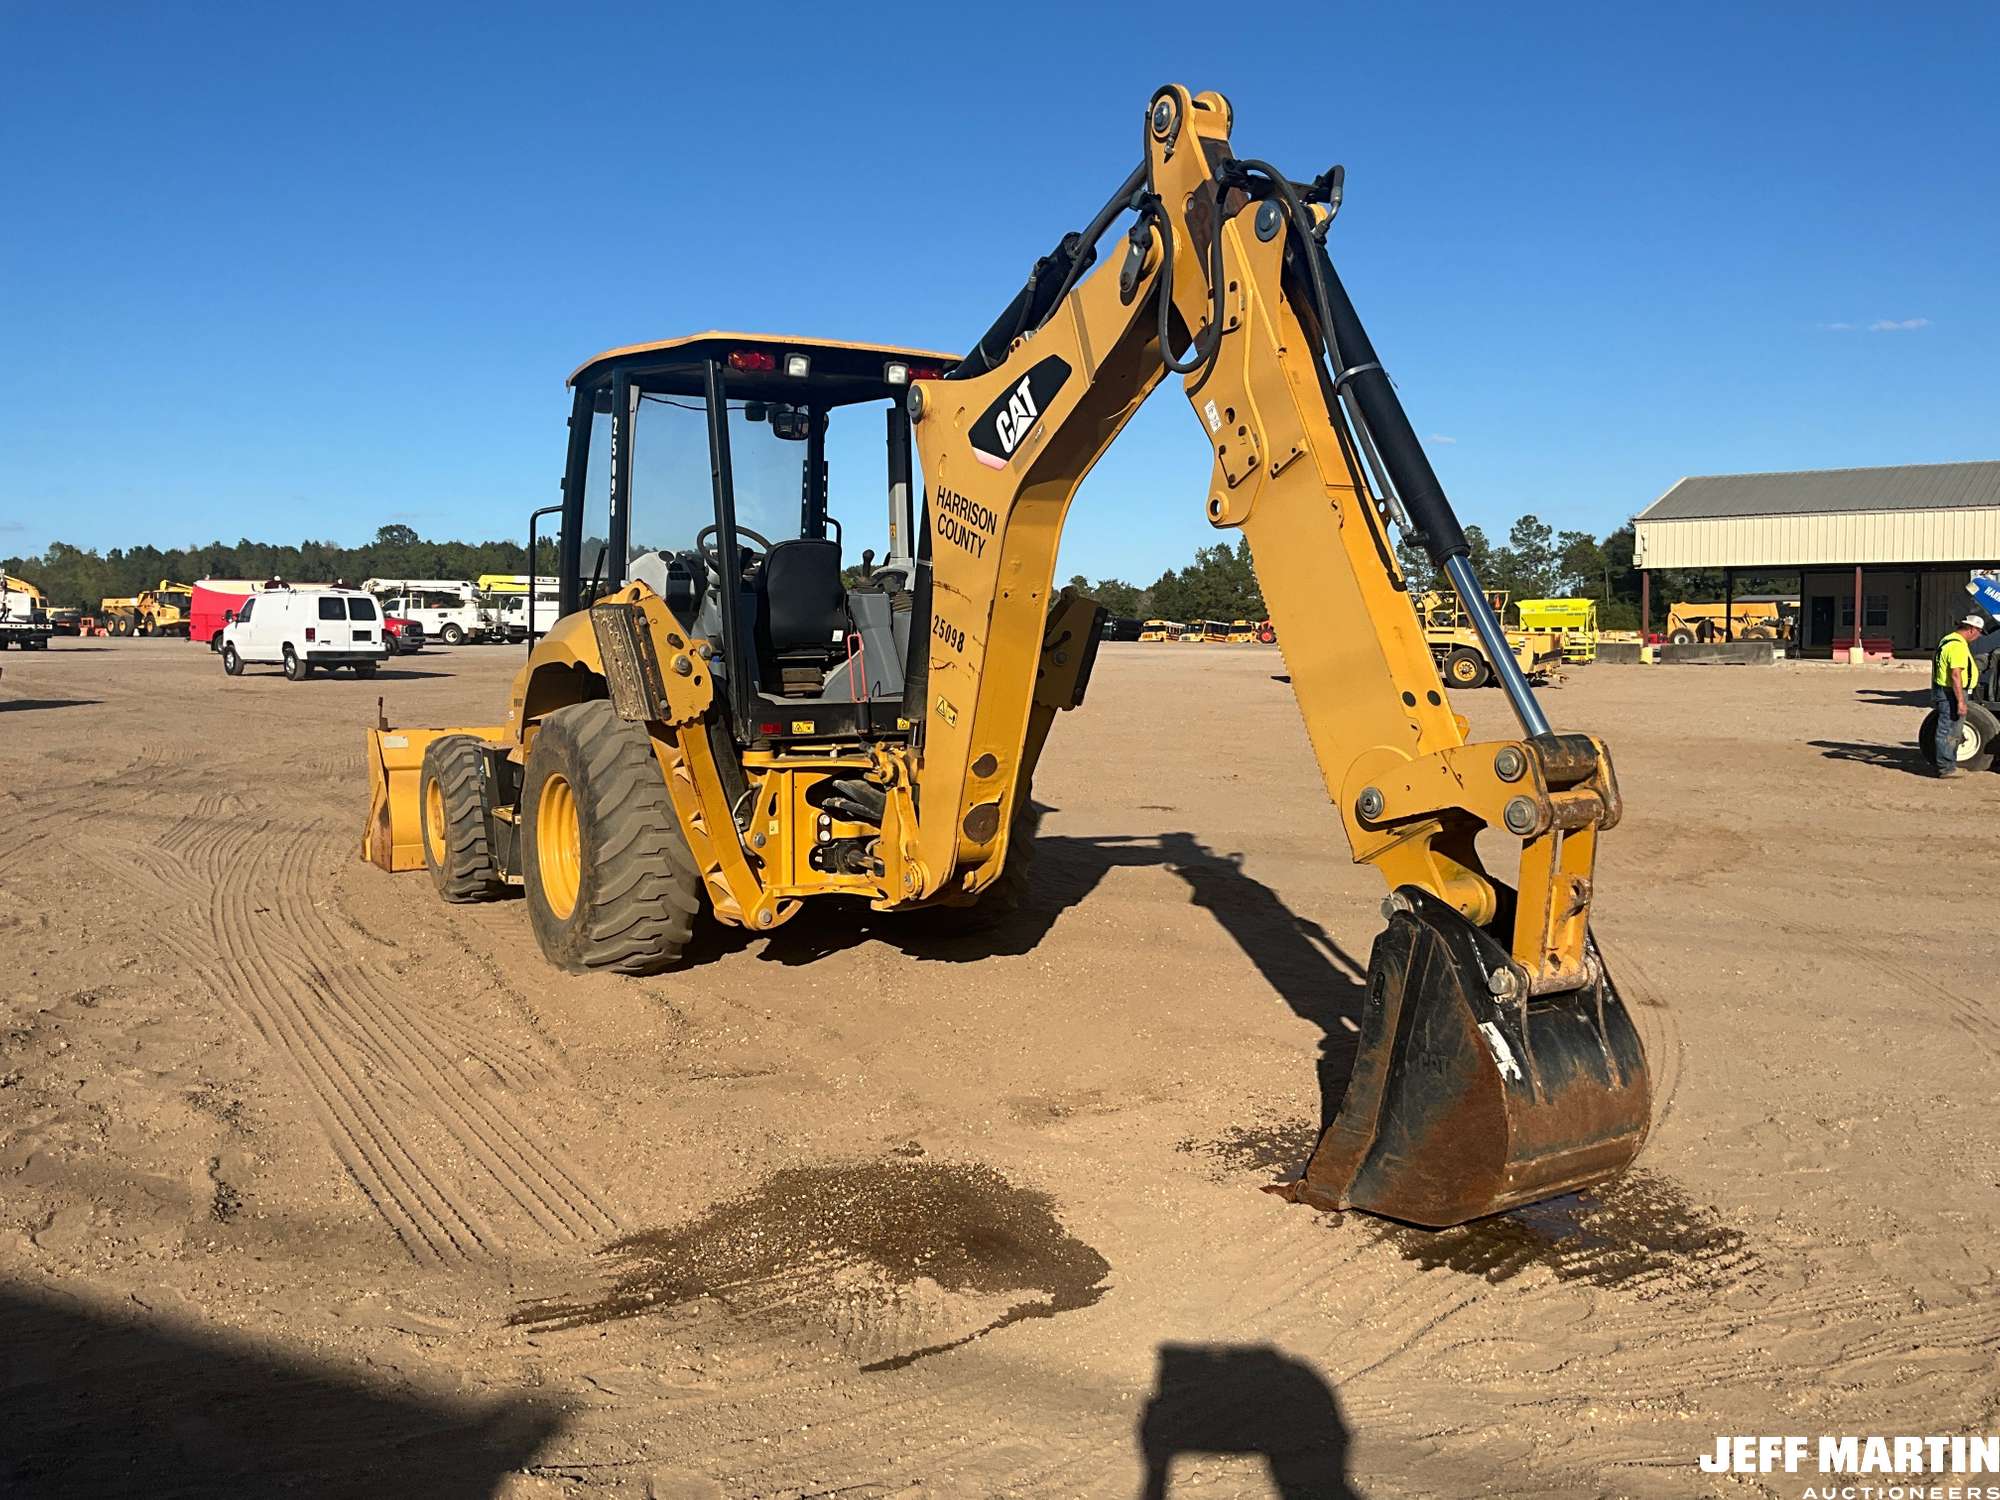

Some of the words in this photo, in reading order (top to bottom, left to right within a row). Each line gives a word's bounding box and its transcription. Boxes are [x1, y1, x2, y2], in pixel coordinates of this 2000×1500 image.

[996, 375, 1038, 453] CAT
[610, 416, 618, 517] 25098
[936, 484, 998, 536] HARRISON
[937, 513, 986, 559] COUNTY
[932, 614, 965, 653] 25098
